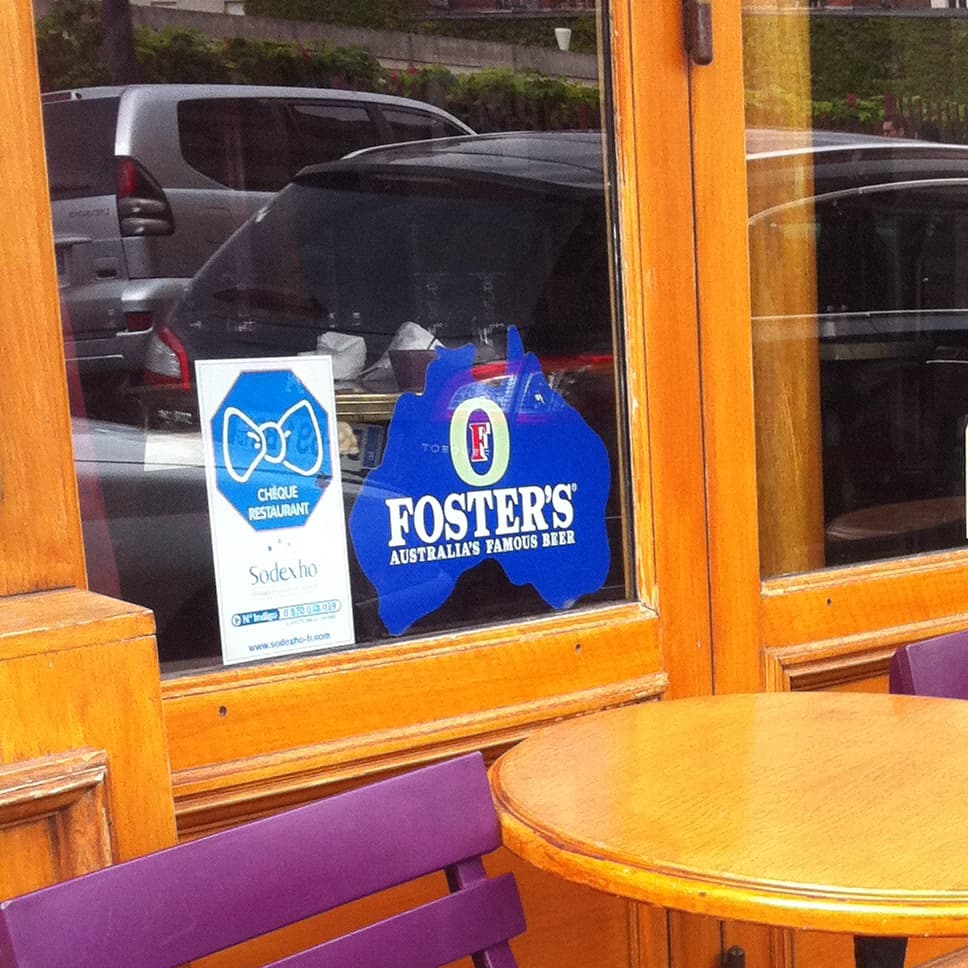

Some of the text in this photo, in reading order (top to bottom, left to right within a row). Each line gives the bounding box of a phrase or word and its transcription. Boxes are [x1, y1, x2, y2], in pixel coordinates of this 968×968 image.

[248, 501, 310, 521] RESTAURANT
[385, 482, 575, 548] FOSTER'S
[389, 529, 577, 566] AUSTRALIA'S FAMOUS BEER
[249, 559, 318, 586] Sodexho
